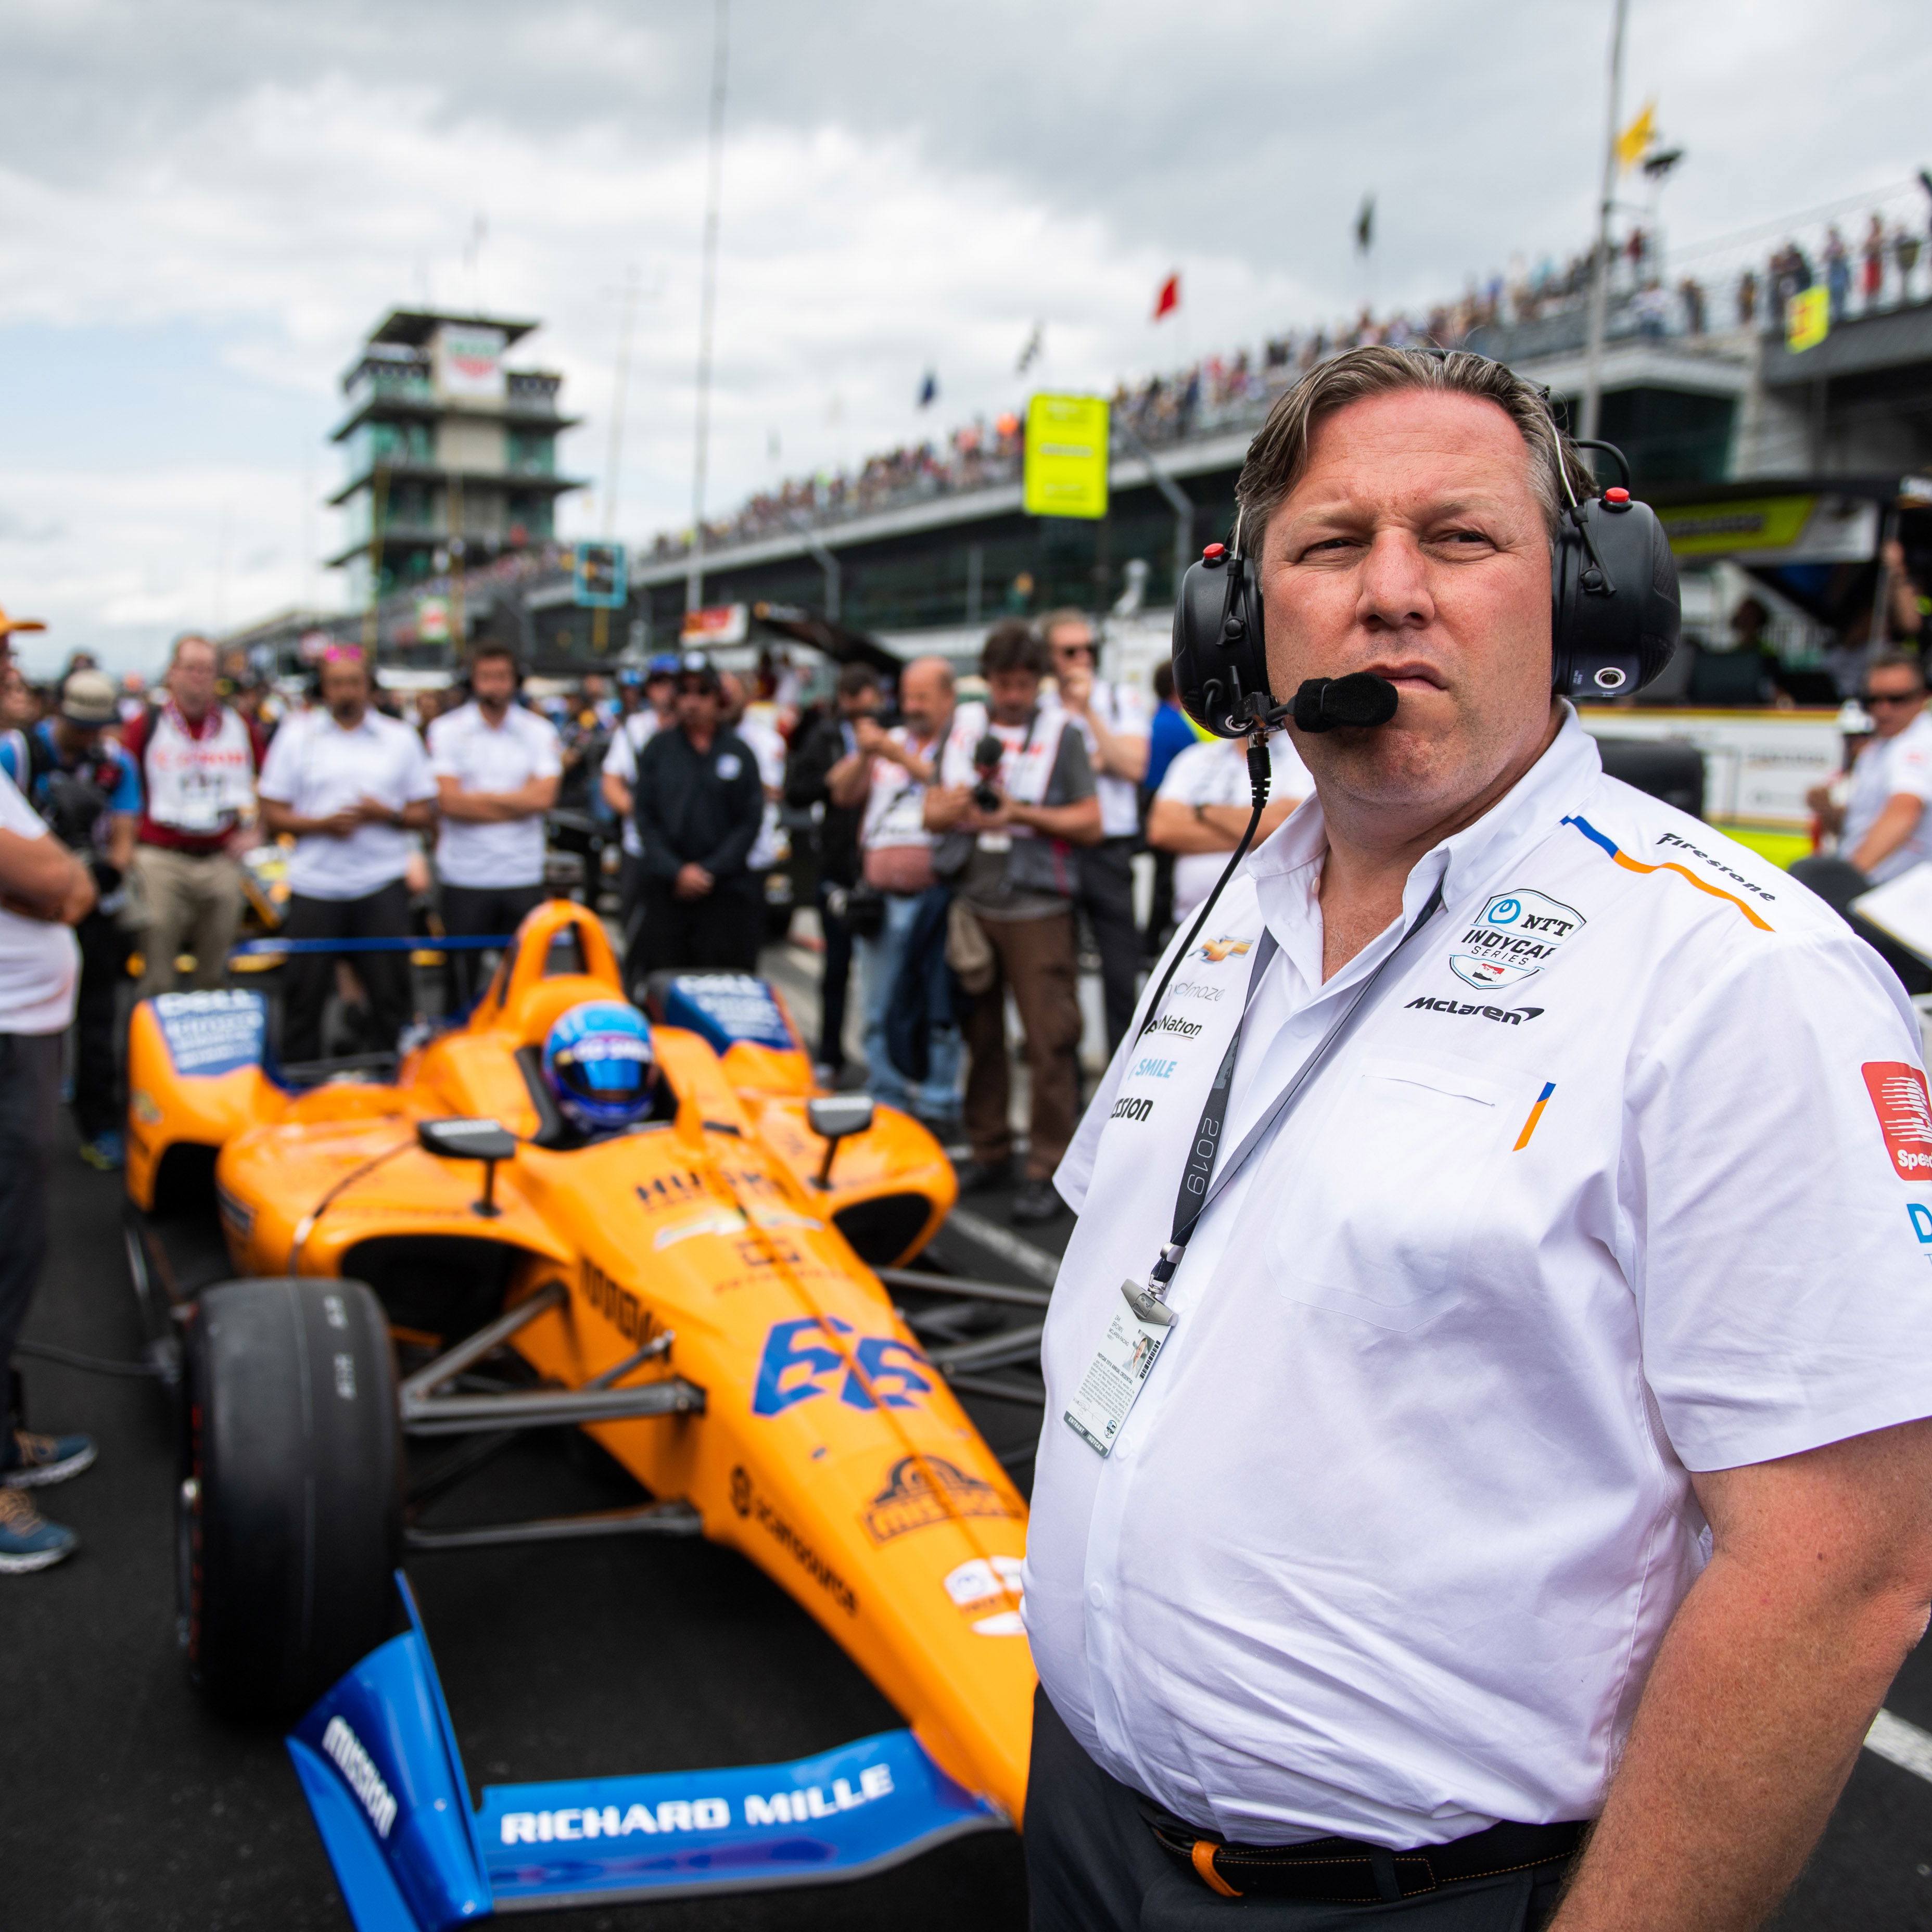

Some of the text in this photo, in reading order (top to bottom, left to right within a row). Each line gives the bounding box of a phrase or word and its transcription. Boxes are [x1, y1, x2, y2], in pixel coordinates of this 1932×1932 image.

[1655, 833, 1775, 901] Firestone
[1520, 914, 1574, 937] NTT
[1471, 946, 1529, 965] SERIES
[1403, 997, 1522, 1026] McLaren
[1135, 1058, 1177, 1078] SMILE
[1187, 1117, 1219, 1195] 2019
[751, 1316, 933, 1418] 66
[1068, 1416, 1085, 1433] ENTRANT
[1087, 1434, 1103, 1452] INDYCAR
[500, 1762, 895, 1845] RICHARD MILLE
